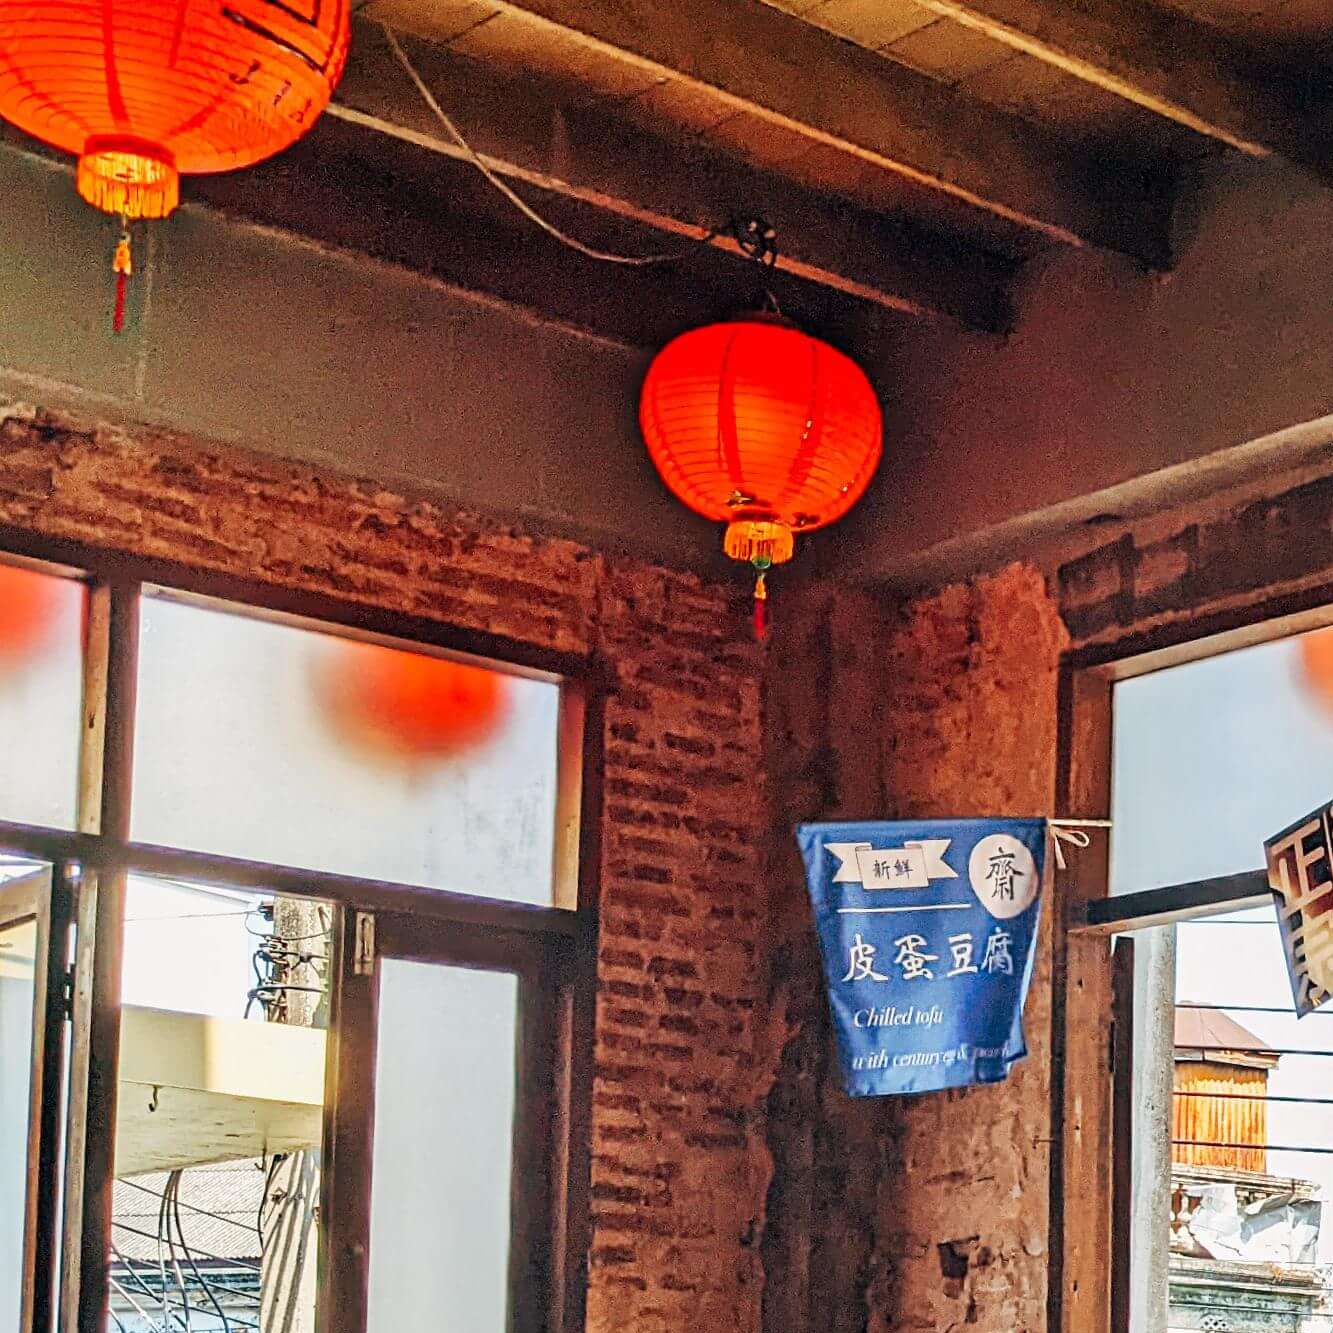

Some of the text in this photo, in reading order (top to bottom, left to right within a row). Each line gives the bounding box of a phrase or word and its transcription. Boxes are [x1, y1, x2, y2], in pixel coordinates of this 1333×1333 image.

[872, 858, 913, 880] 新鮮
[841, 926, 1014, 982] 皮蛋豆腐
[853, 1004, 944, 1030] Chilled tofu
